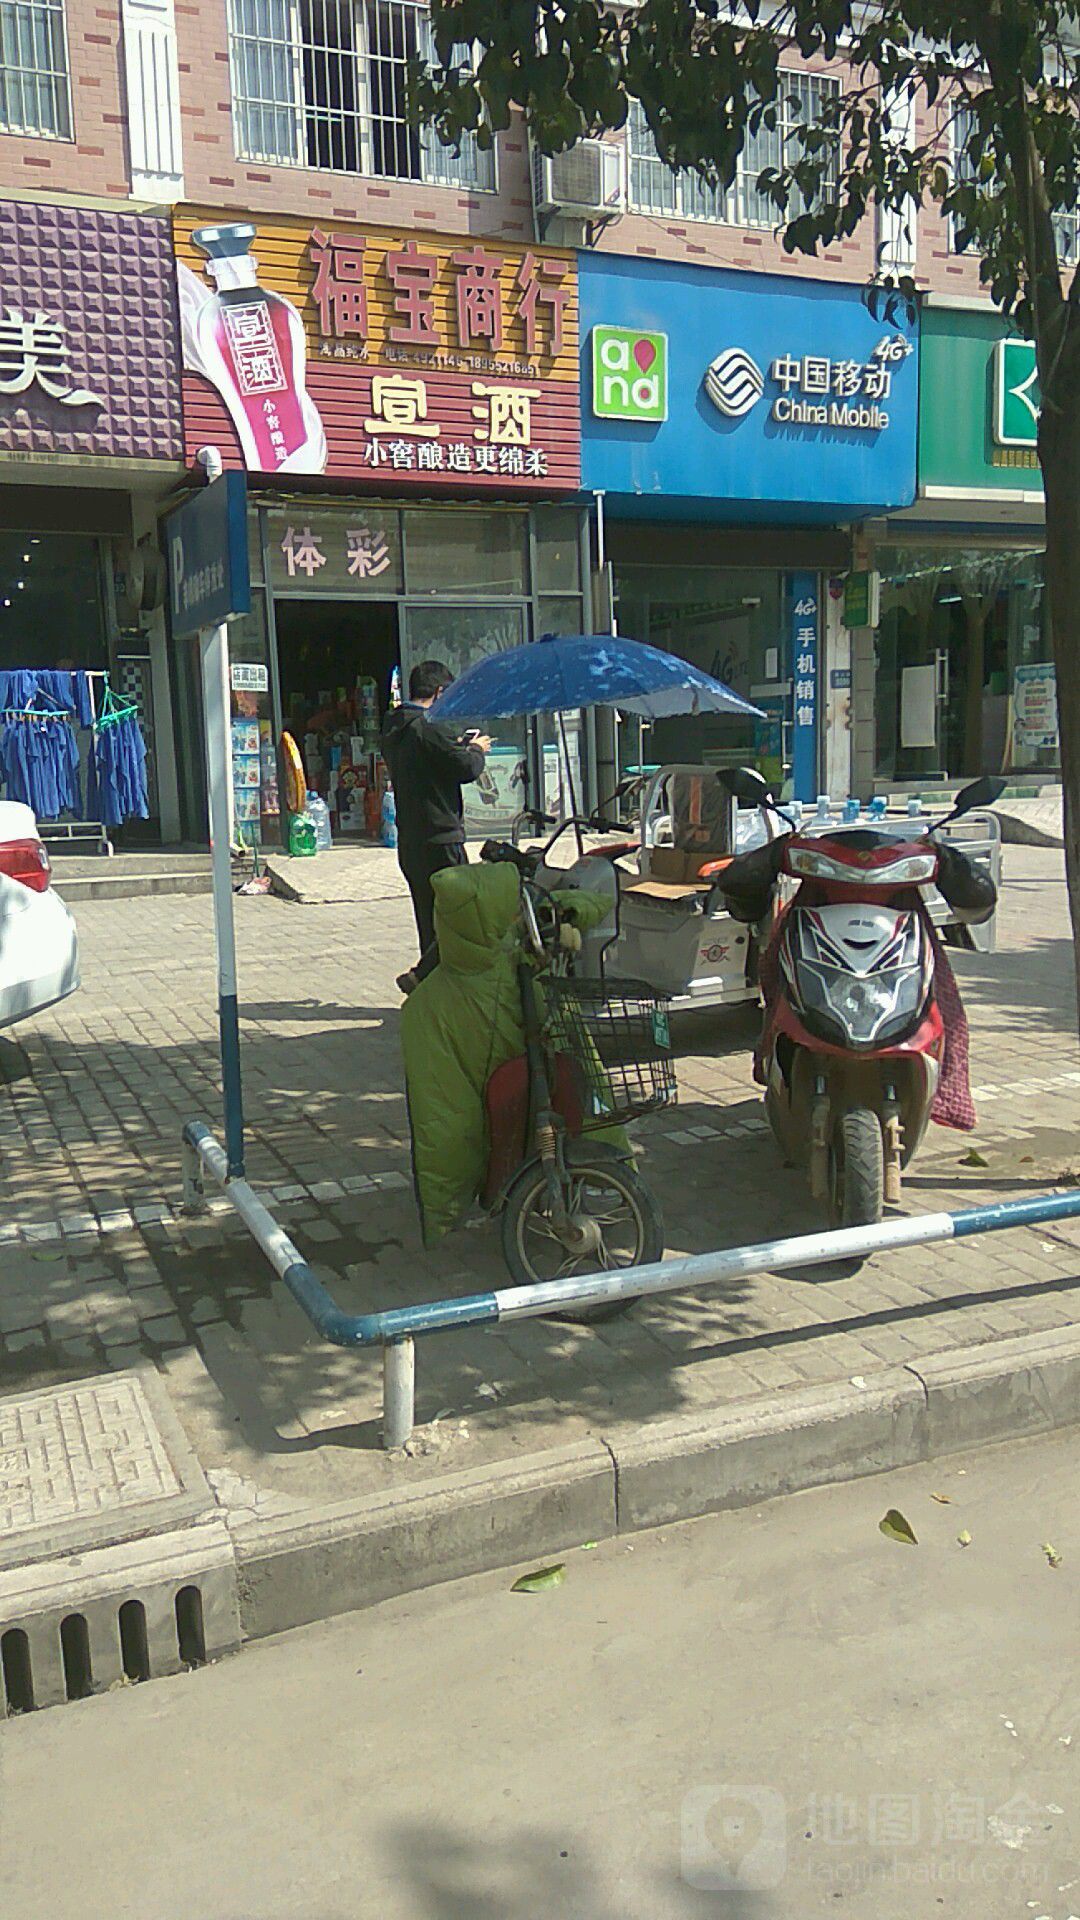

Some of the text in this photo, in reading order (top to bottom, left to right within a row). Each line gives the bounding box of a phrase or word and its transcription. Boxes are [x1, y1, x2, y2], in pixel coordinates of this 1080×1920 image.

[310, 226, 571, 356] 福宝商行
[0, 311, 102, 406] 美
[237, 312, 274, 386] 宣酒
[773, 353, 892, 398] 中国移动
[363, 374, 542, 446] 宣酒
[774, 397, 890, 428] China Mobile
[364, 438, 549, 475] 小窖酿造更绵柔
[173, 536, 183, 614] P
[281, 526, 391, 578] 体彩
[797, 627, 816, 726] 手机销售
